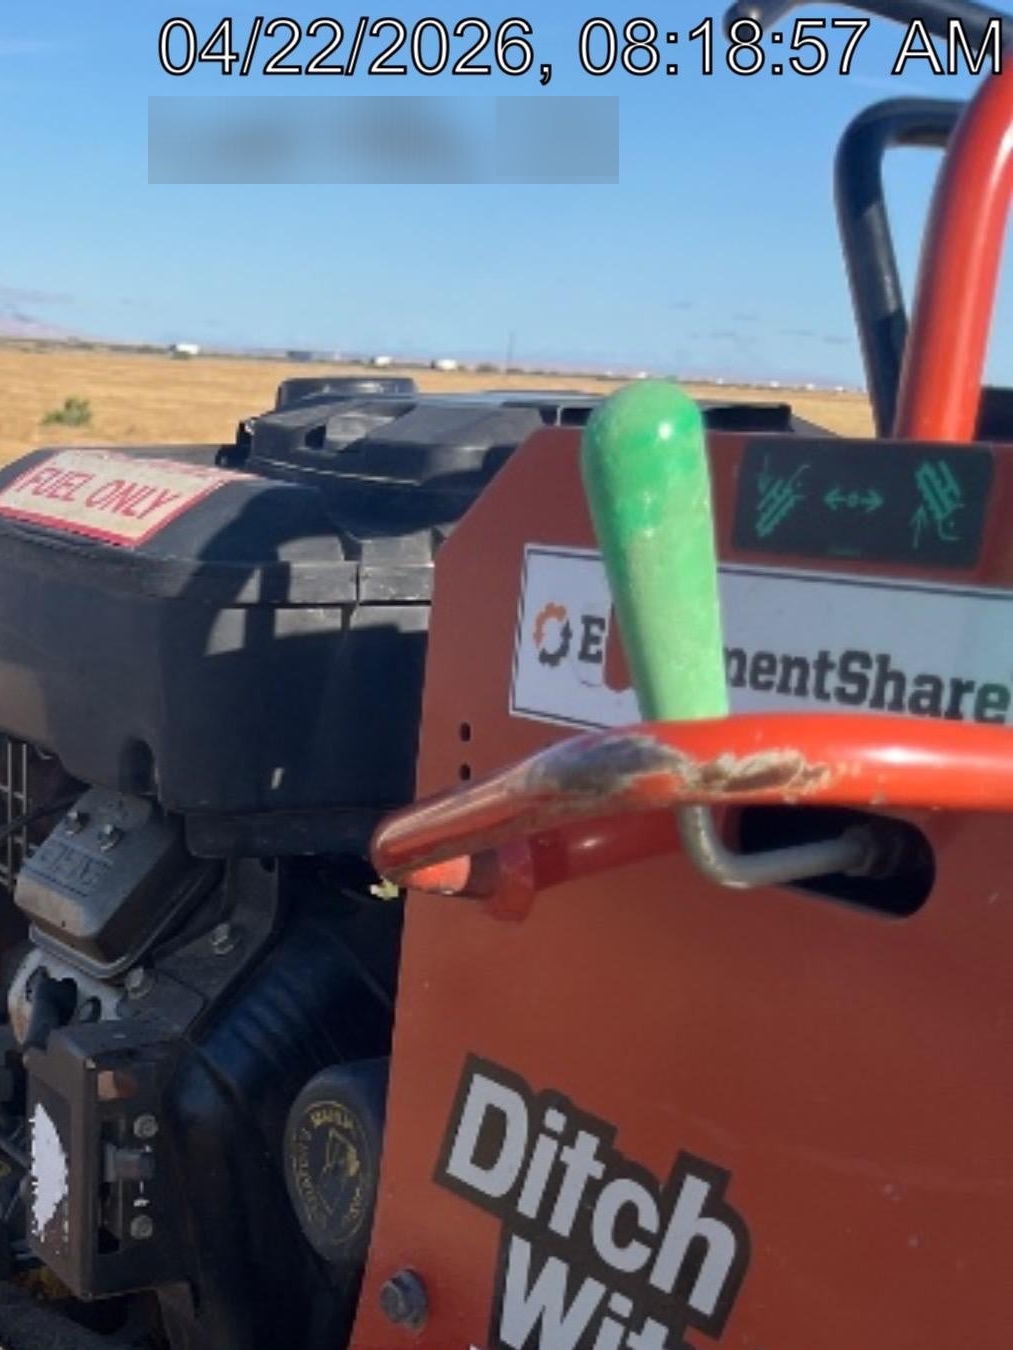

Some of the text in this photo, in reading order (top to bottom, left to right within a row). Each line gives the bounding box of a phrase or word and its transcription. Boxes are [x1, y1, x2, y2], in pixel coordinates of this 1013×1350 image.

[16, 467, 181, 520] FUEL ONLY
[447, 1072, 737, 1317] Ditch
